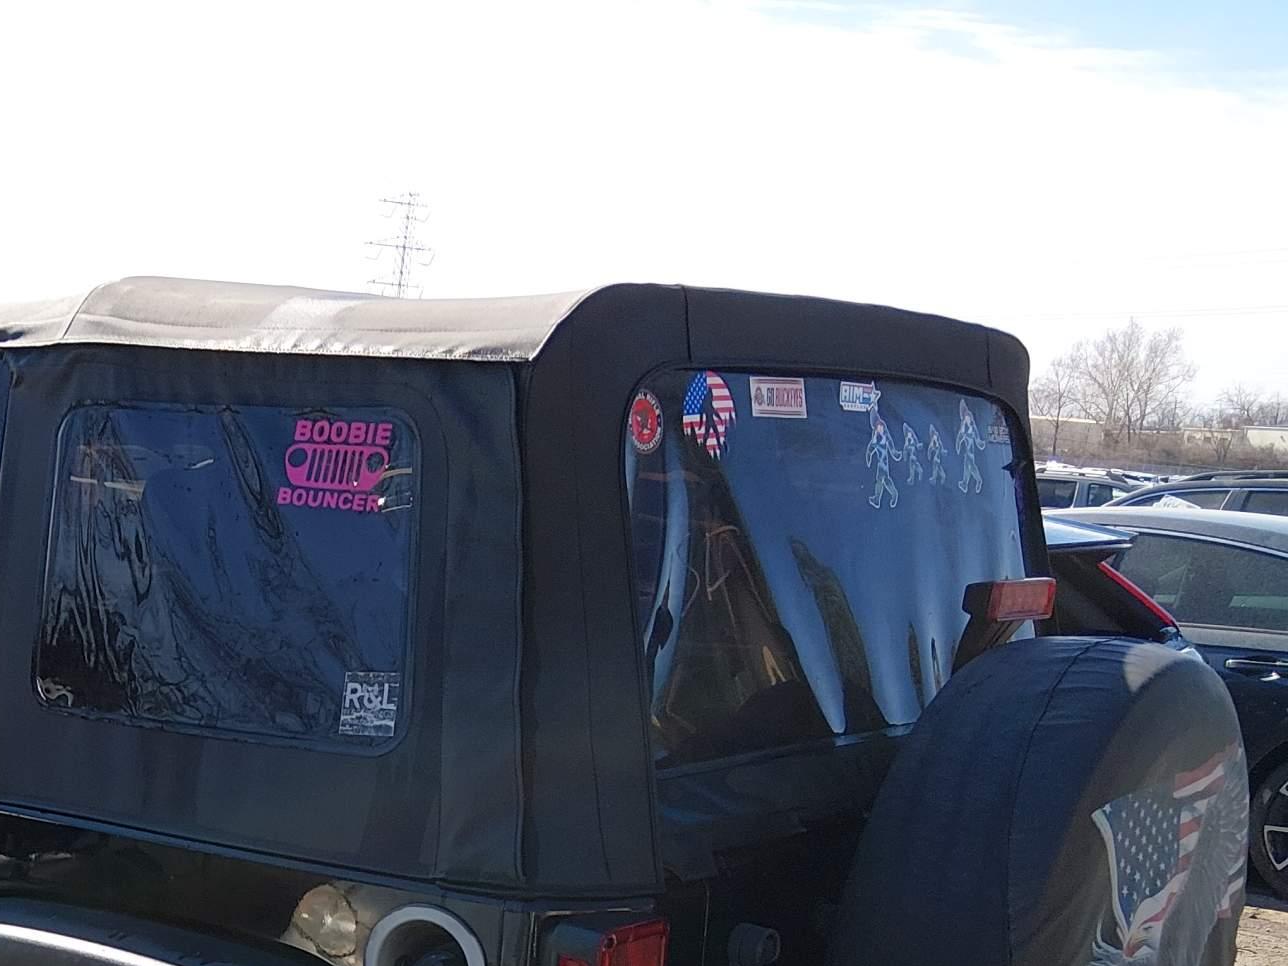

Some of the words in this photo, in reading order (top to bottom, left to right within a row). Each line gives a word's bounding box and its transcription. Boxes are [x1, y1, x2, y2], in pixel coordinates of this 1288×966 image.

[294, 419, 393, 445] BOOBIE
[277, 487, 382, 512] BOUNCER
[344, 682, 395, 711] R&L
